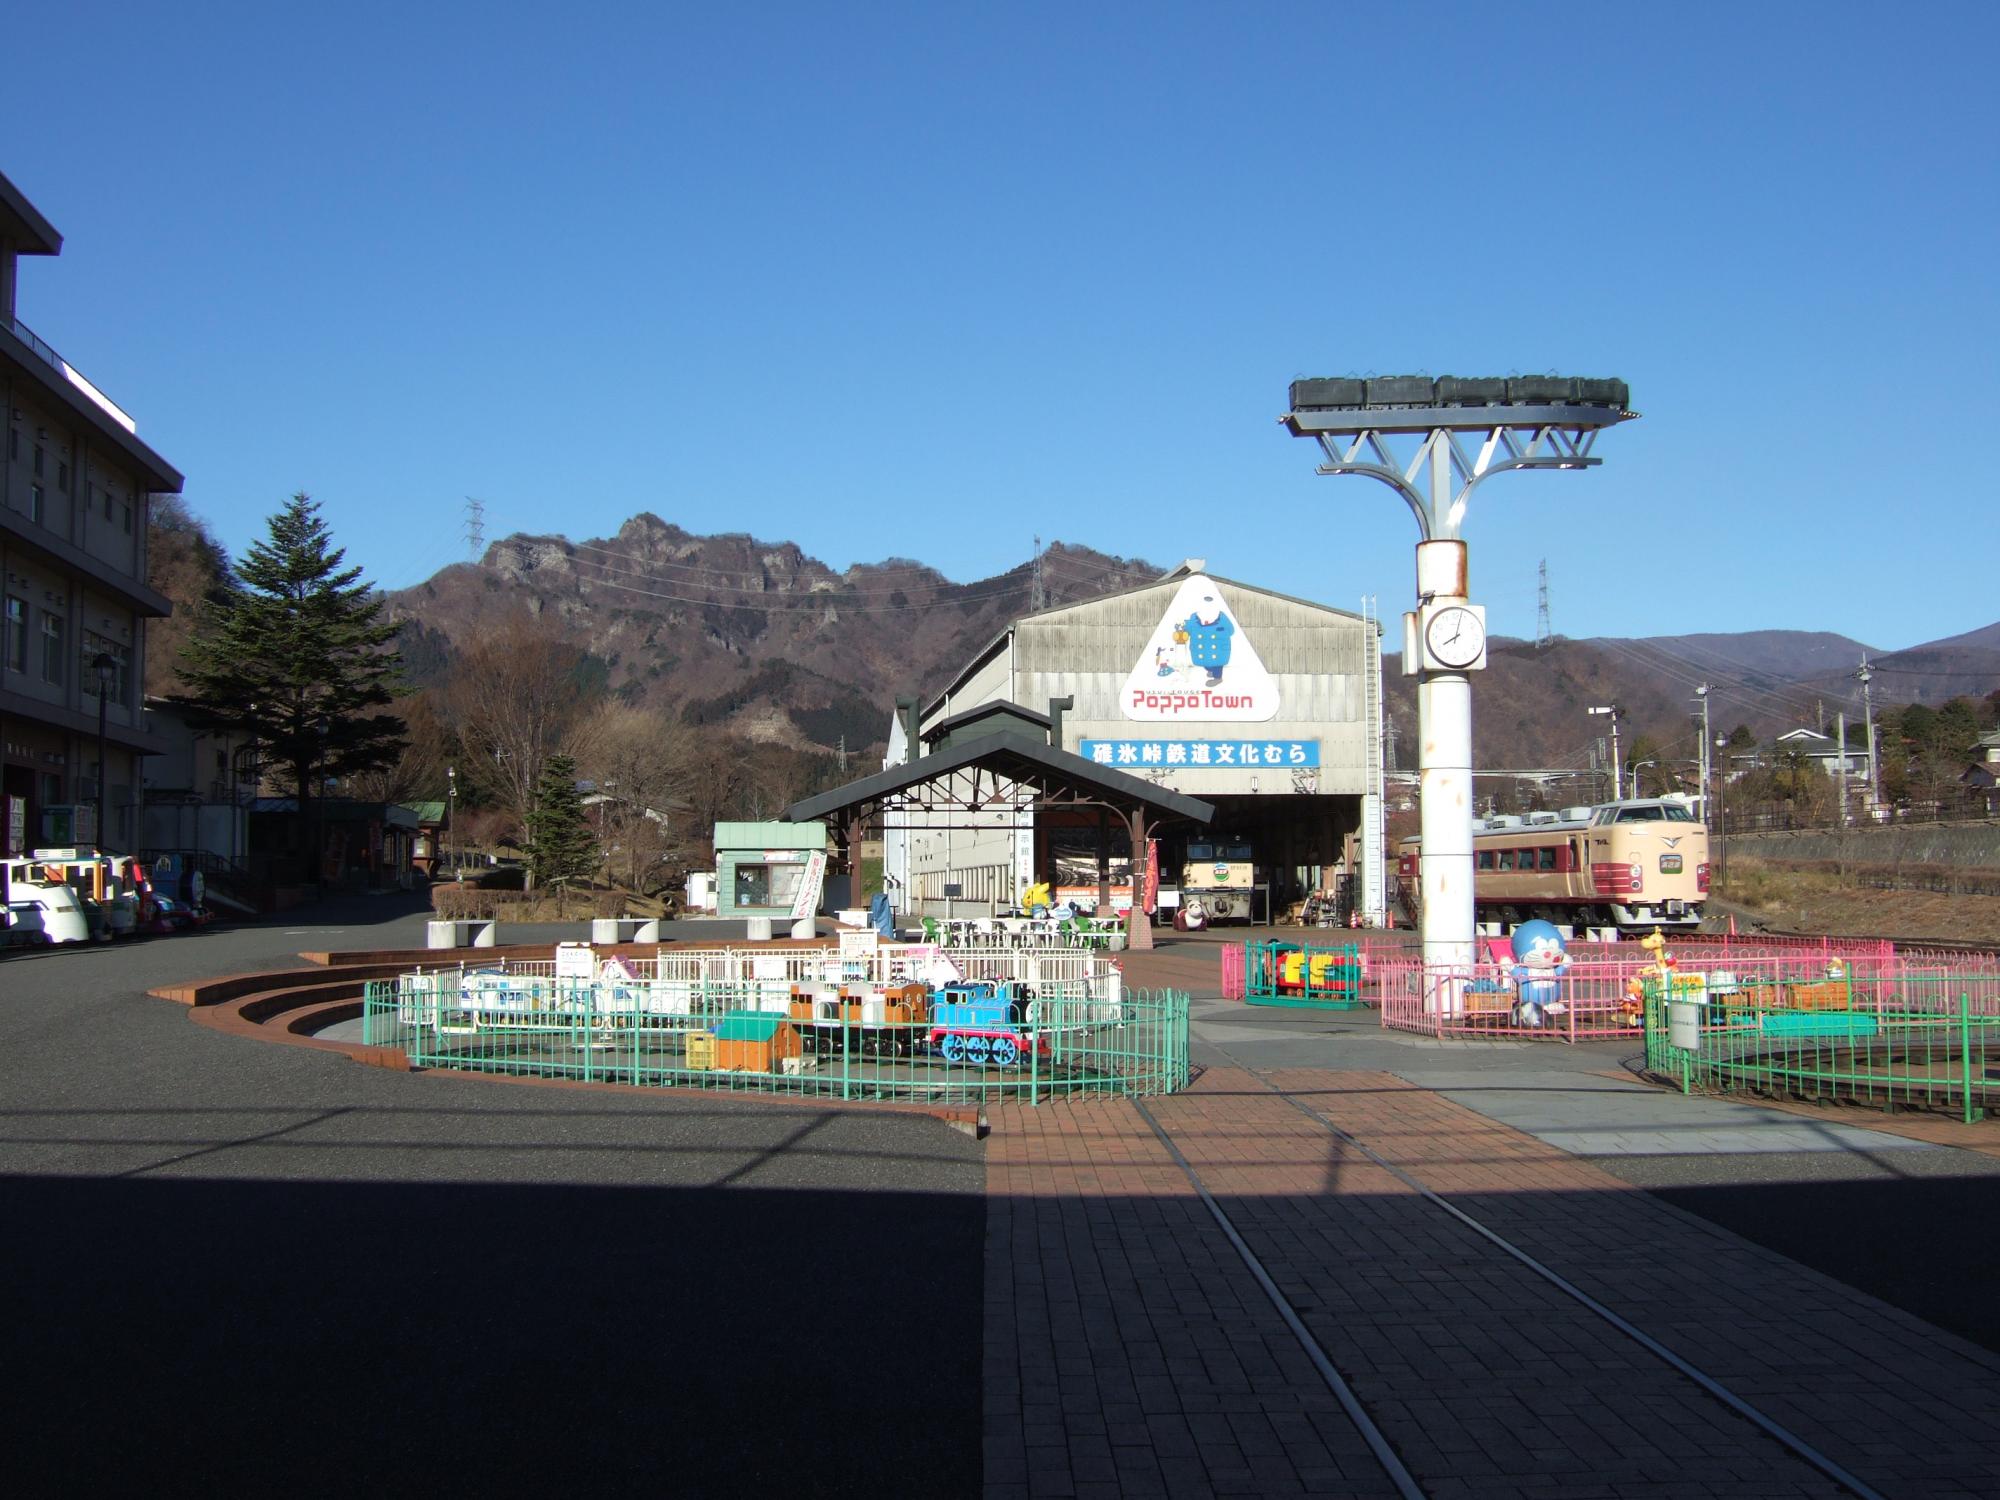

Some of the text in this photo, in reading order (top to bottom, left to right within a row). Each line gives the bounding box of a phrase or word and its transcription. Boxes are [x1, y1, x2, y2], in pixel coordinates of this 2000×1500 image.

[1092, 743, 1307, 764] 碓氷峠鉄道文化むら
[970, 1011, 976, 1025] 1
